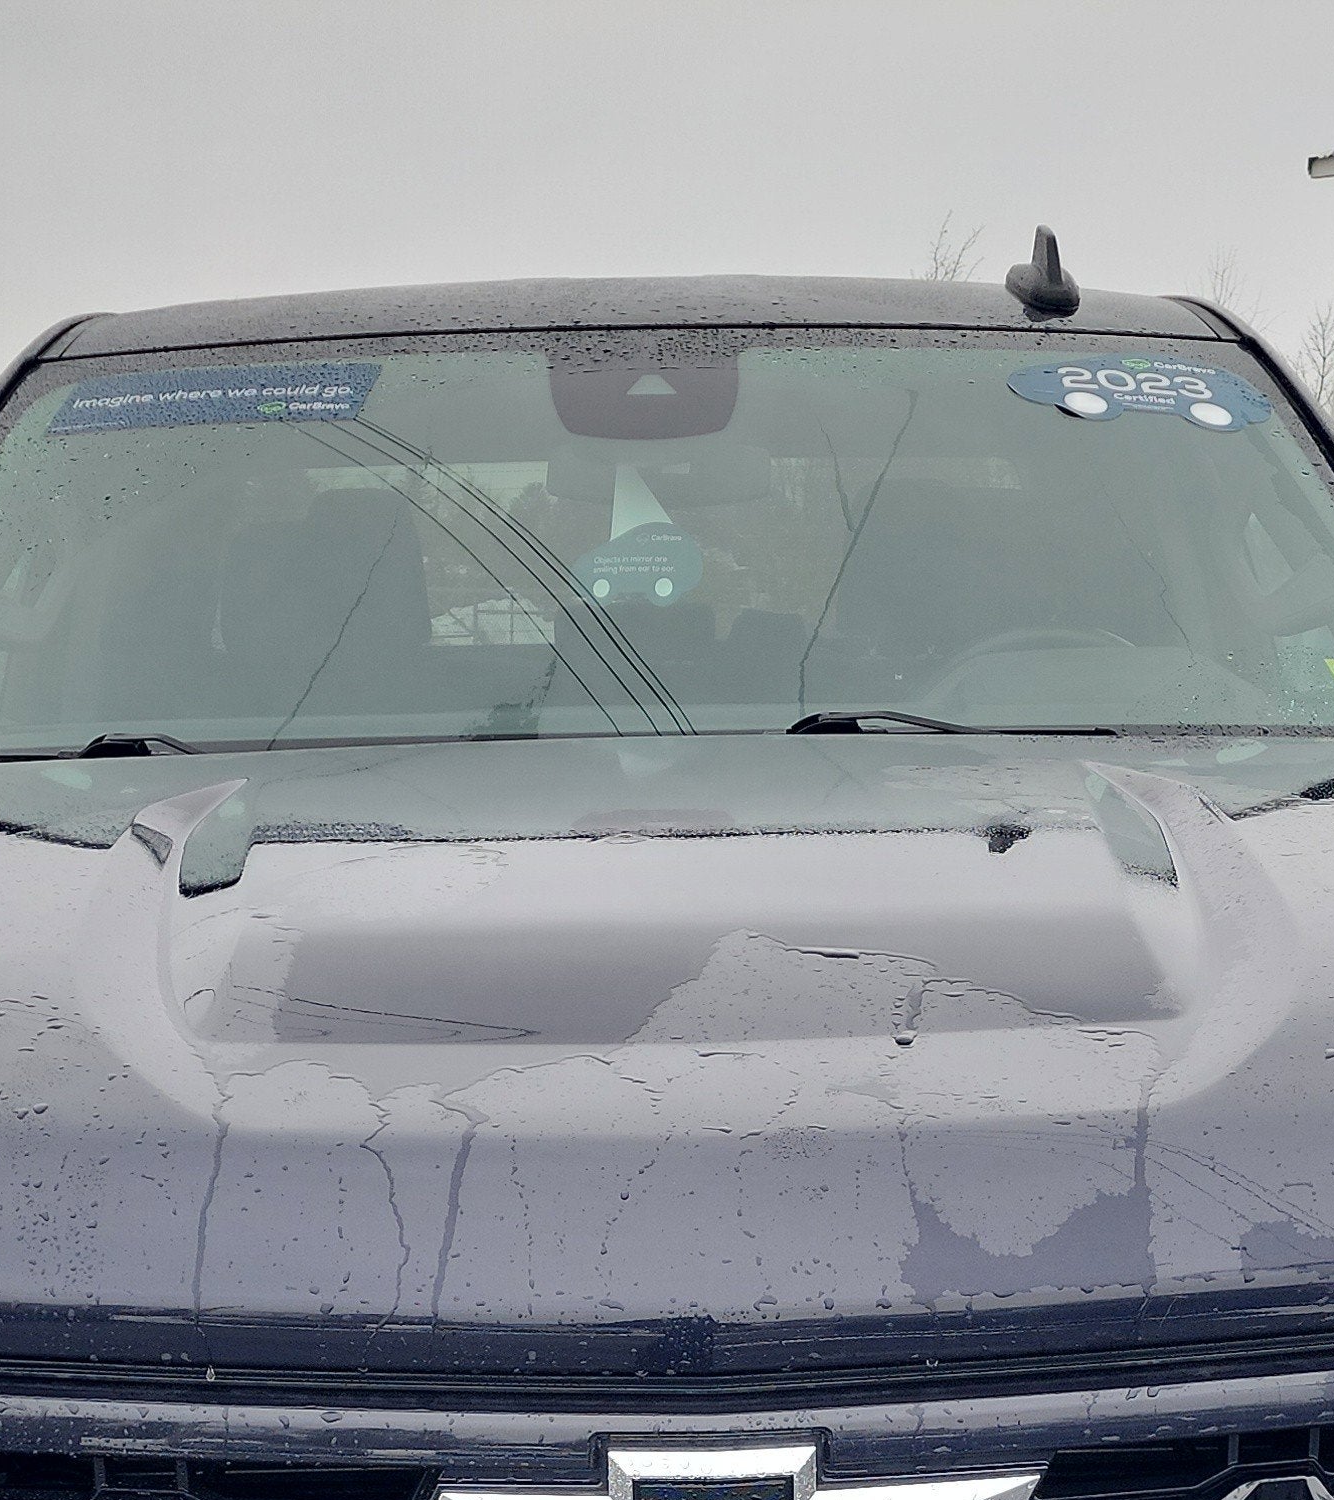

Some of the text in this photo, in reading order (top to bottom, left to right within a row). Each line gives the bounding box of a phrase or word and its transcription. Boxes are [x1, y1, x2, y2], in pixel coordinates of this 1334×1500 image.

[1057, 366, 1213, 399] 2023
[72, 384, 354, 409] Imagine where we could go.
[1113, 392, 1175, 405] Certified
